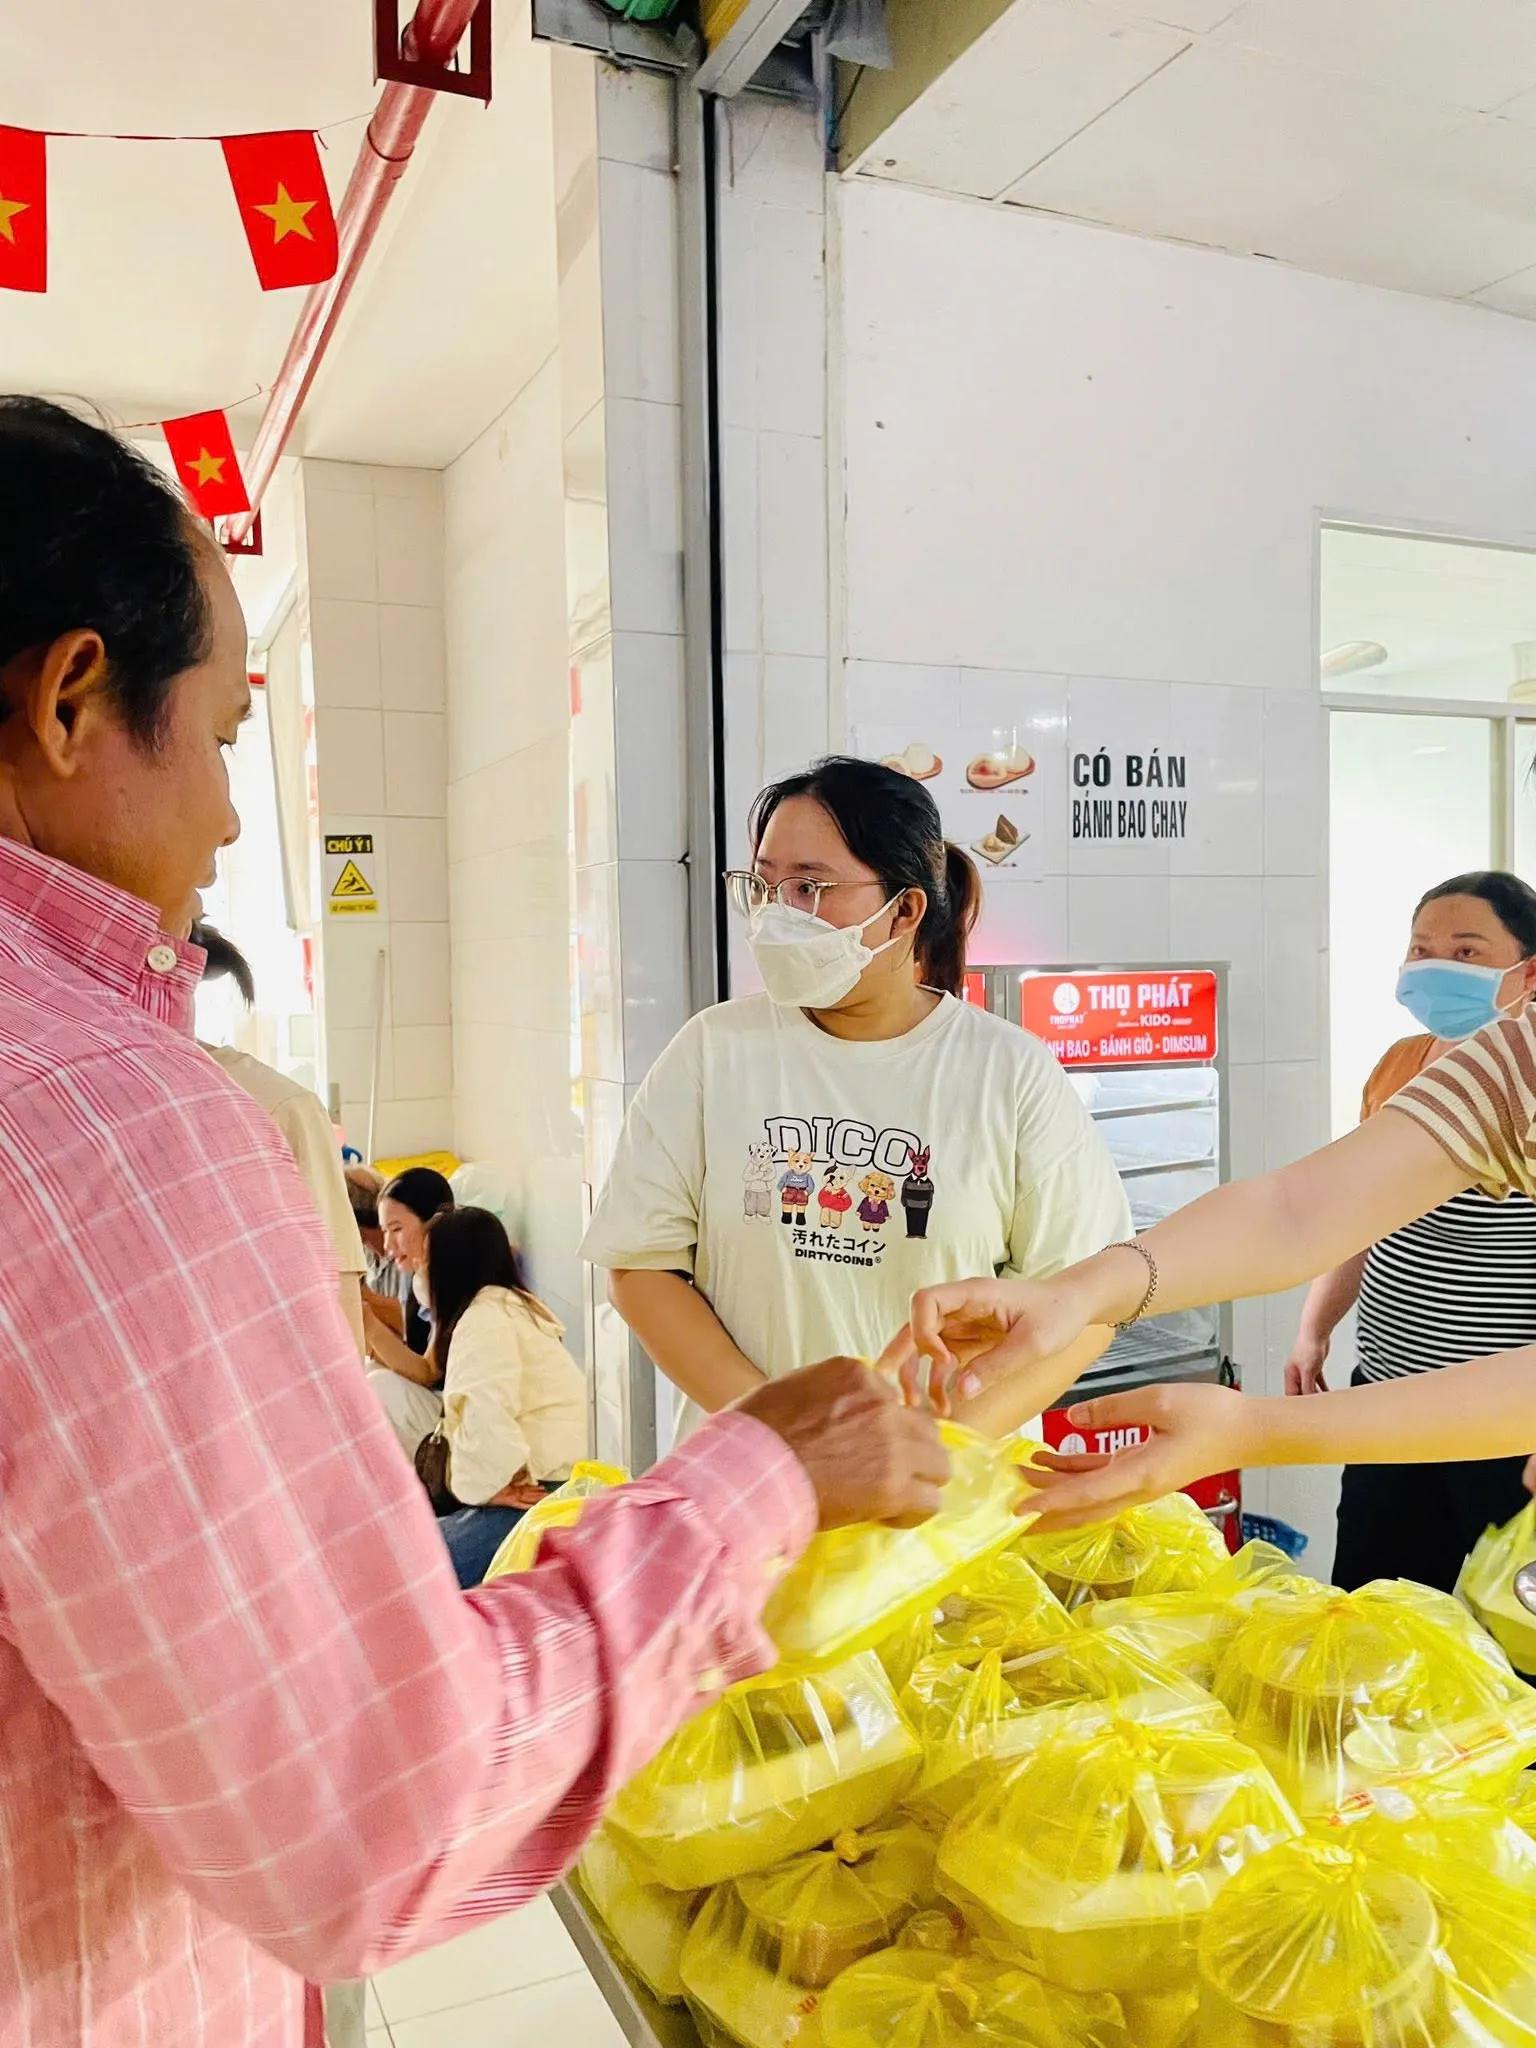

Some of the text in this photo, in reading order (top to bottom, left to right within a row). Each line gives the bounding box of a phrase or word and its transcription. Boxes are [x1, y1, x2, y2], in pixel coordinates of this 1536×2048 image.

[1073, 746, 1186, 788] CÓ BÁN
[1072, 790, 1188, 839] BÁNH BAO CHAY
[327, 837, 353, 853] CHÚ
[354, 837, 364, 852] Ý
[1087, 976, 1193, 1016] THỌ PHÁT
[1140, 1014, 1171, 1027] KIDO
[1066, 1039, 1090, 1058] BAO
[1099, 1034, 1133, 1057] BÁNH
[1134, 1032, 1154, 1055] GIÒ
[1162, 1035, 1207, 1053] DIMSUM
[764, 1116, 922, 1177] DICO
[791, 1228, 887, 1254] 汚れたコイン
